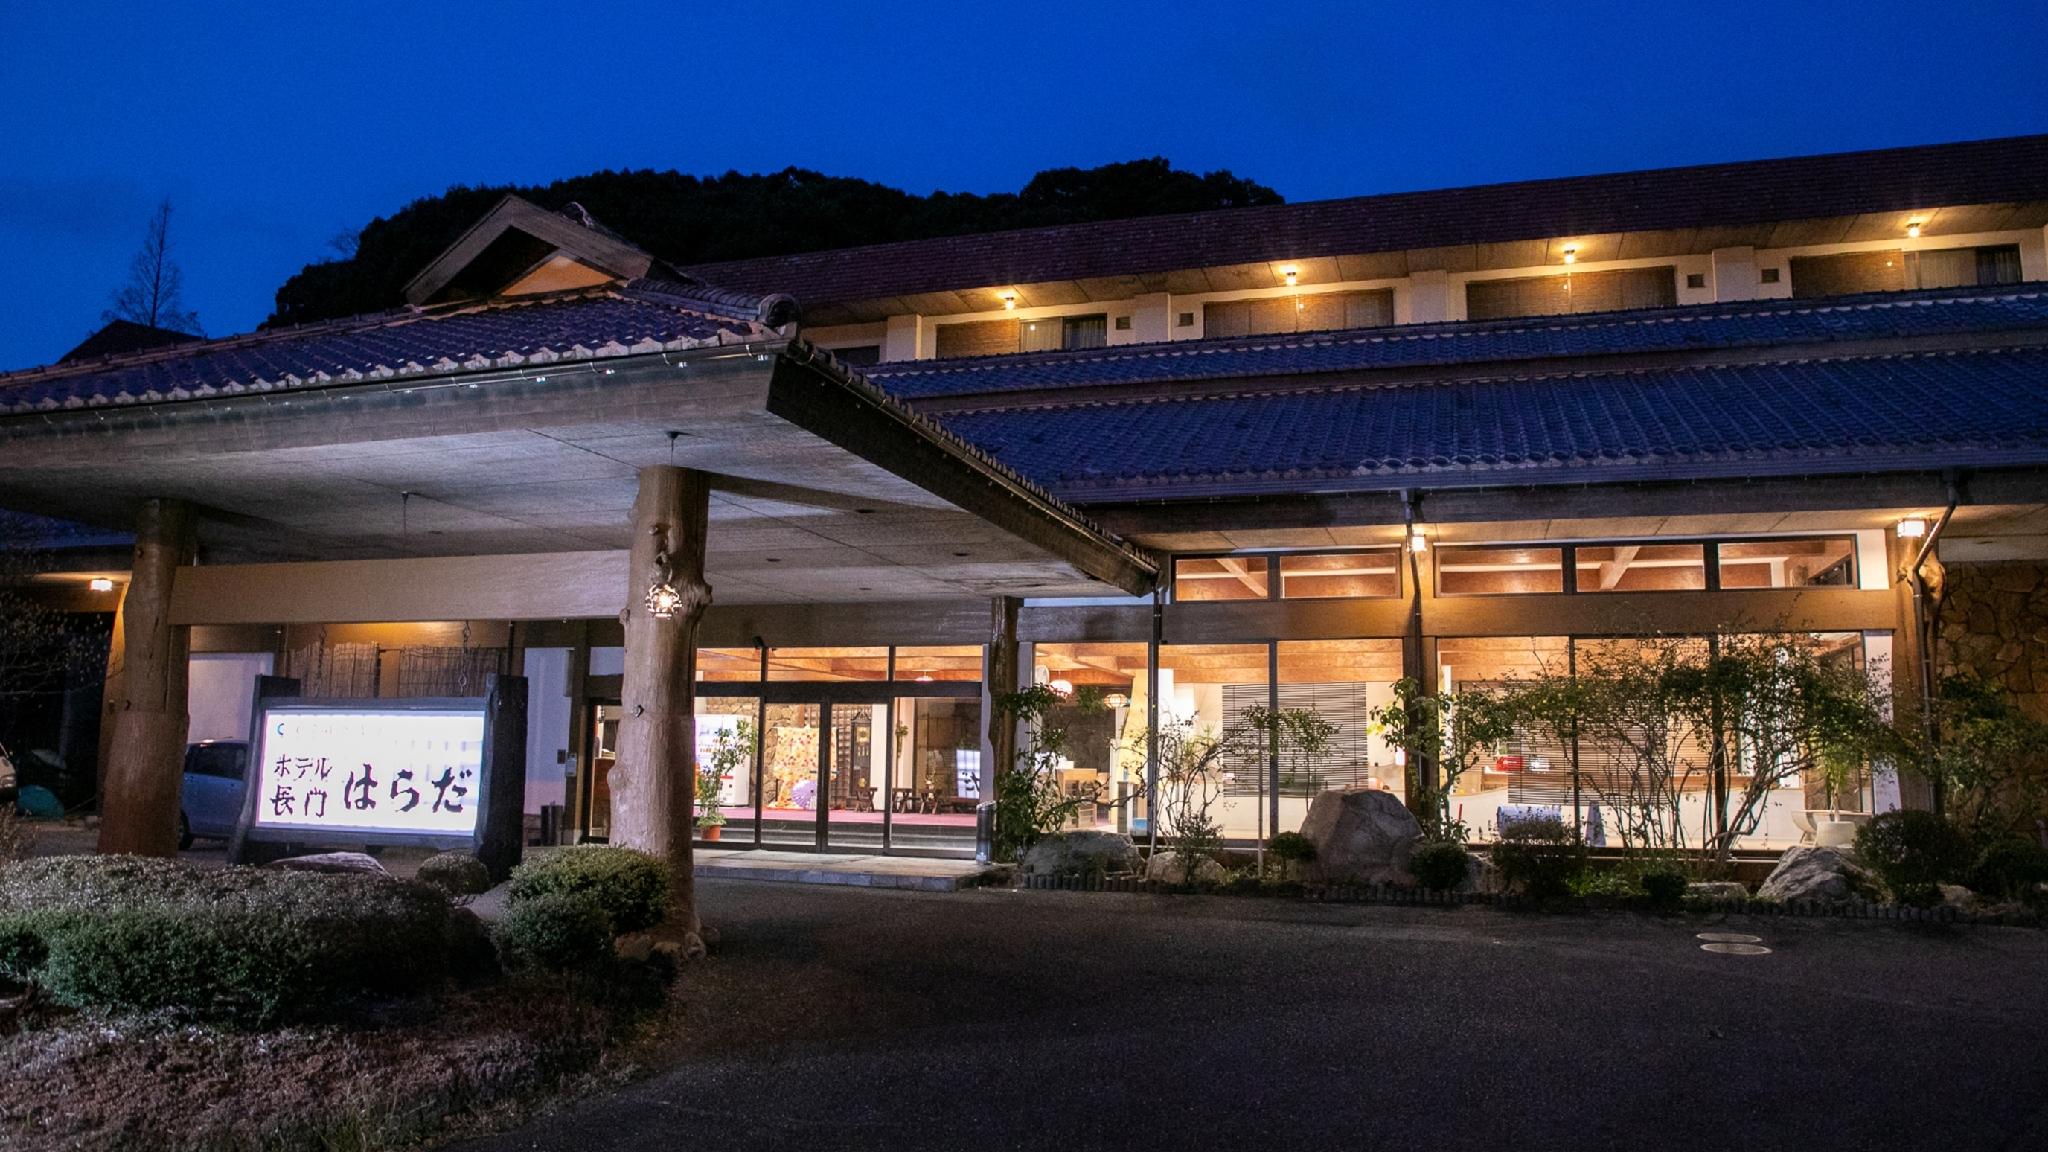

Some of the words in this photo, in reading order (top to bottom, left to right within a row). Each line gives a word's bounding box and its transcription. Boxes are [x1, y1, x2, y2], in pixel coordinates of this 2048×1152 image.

[274, 754, 333, 780] ホテル
[270, 784, 328, 818] 長門
[344, 763, 472, 813] はらだ
